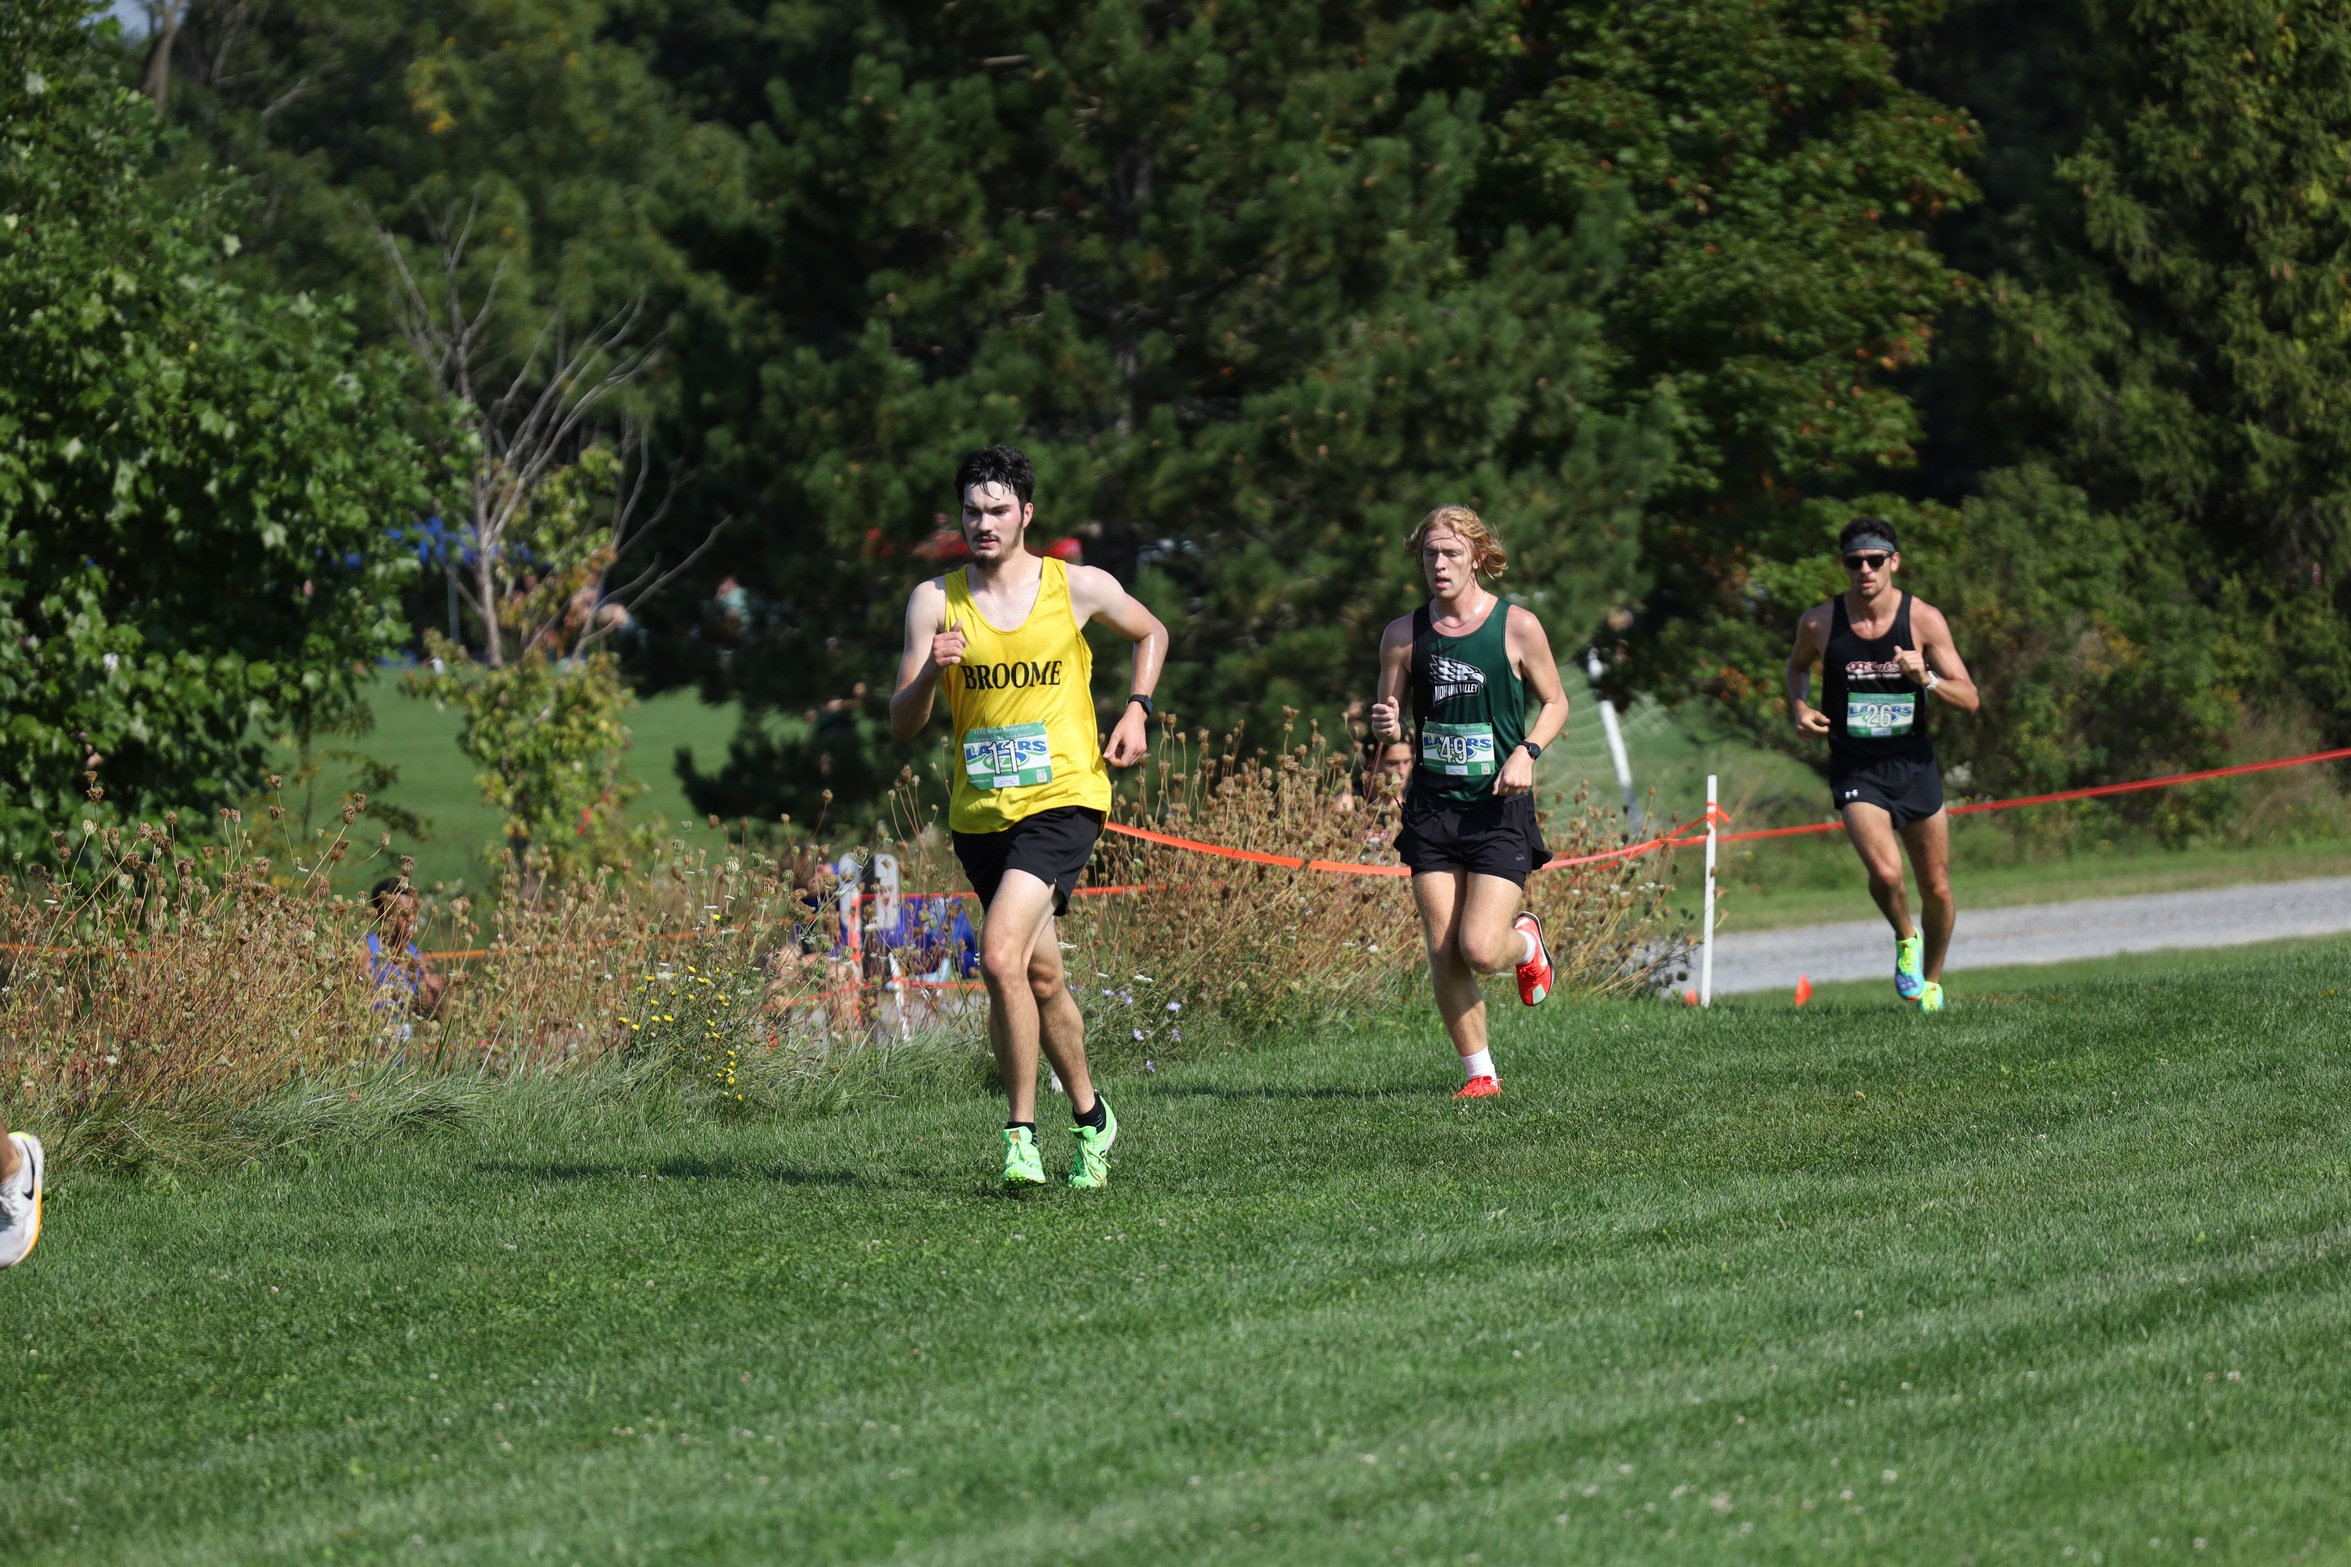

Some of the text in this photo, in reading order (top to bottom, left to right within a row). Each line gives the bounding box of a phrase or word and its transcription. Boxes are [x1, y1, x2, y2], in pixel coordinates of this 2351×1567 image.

[960, 661, 1062, 689] BROOME
[1849, 706, 1911, 715] LARS
[1865, 704, 1892, 727] 26
[966, 740, 1047, 761] LAKRS
[1424, 736, 1492, 748] LARS
[1440, 735, 1468, 765] 49
[987, 740, 1019, 775] 11
